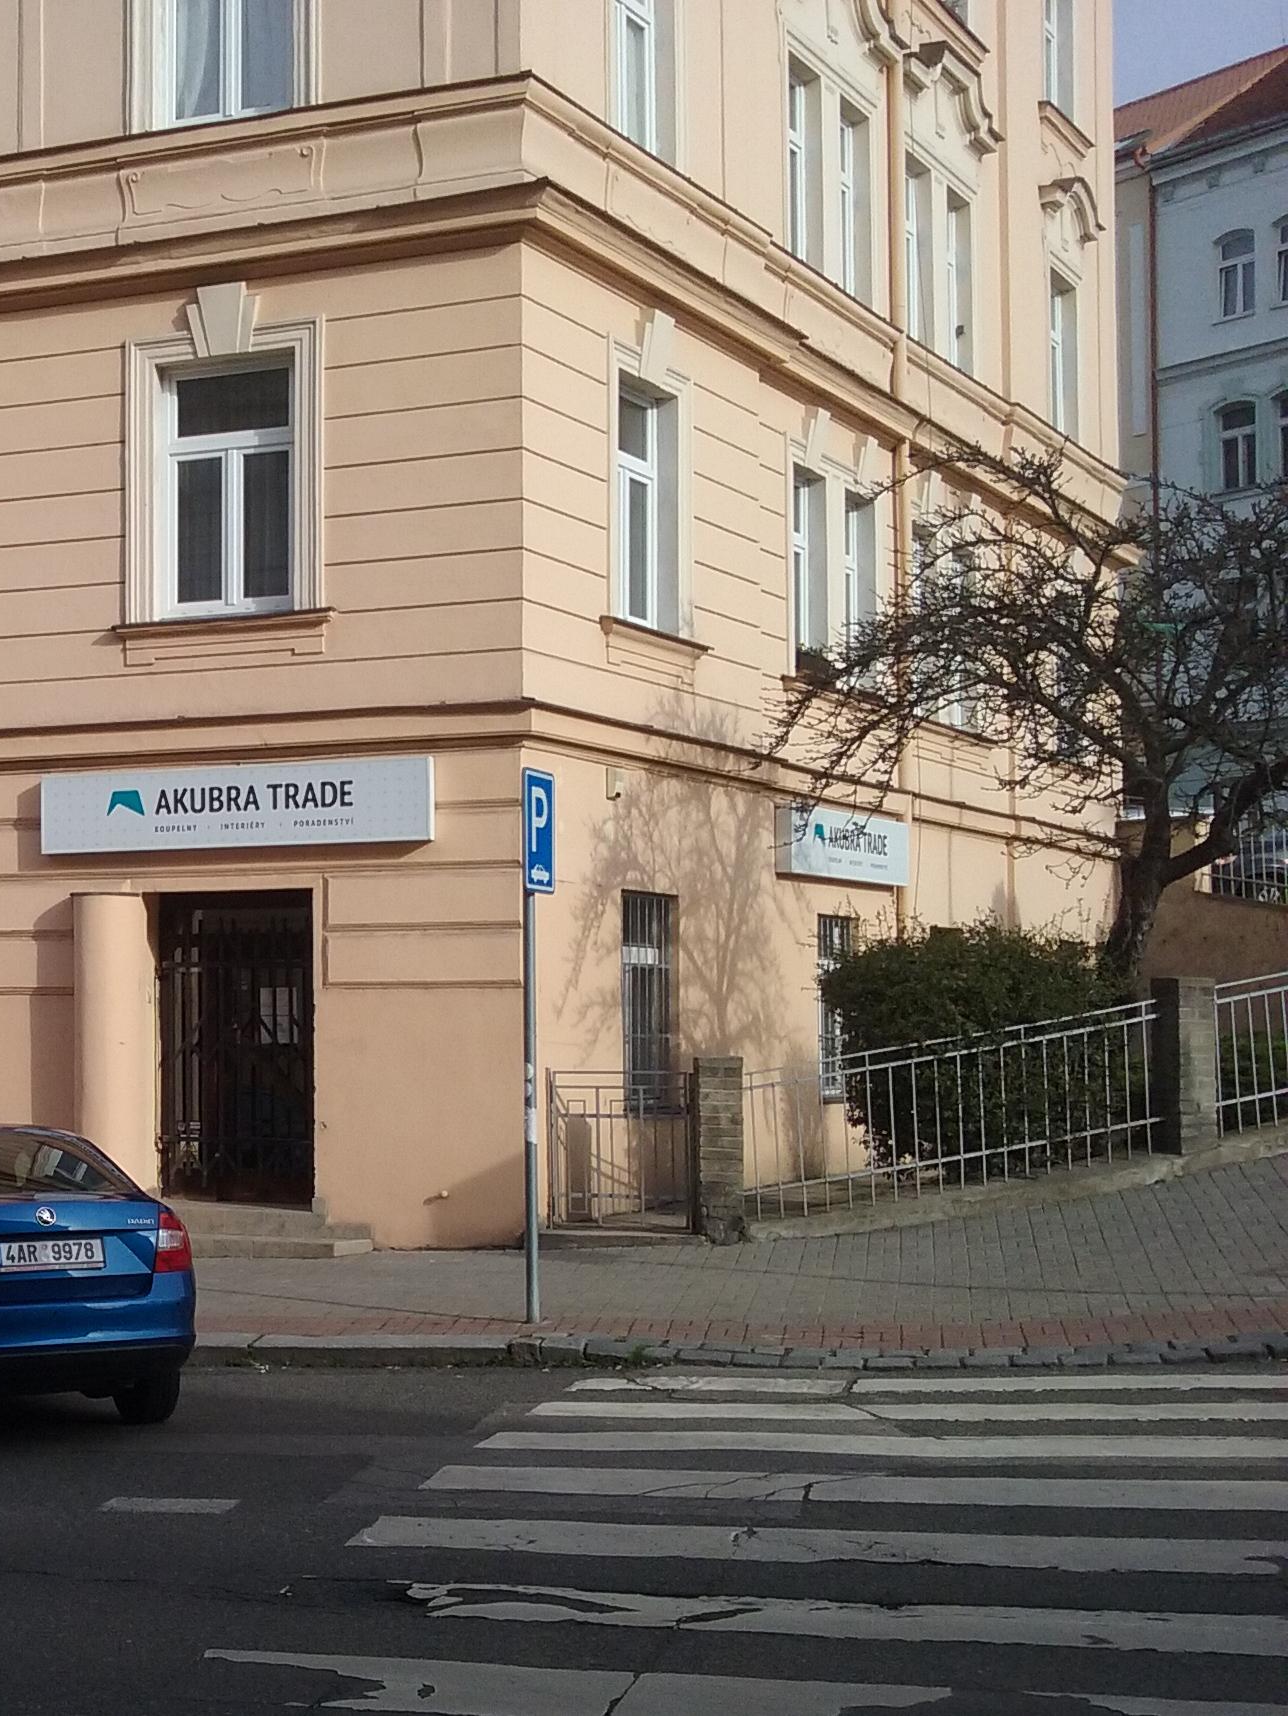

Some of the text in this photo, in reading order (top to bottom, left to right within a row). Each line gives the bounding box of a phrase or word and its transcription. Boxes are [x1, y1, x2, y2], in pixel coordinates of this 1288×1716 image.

[155, 780, 354, 815] AKUBRA TRADE
[531, 786, 548, 852] P
[863, 831, 888, 857] TRADE
[5, 1242, 95, 1263] 4AR 9978
